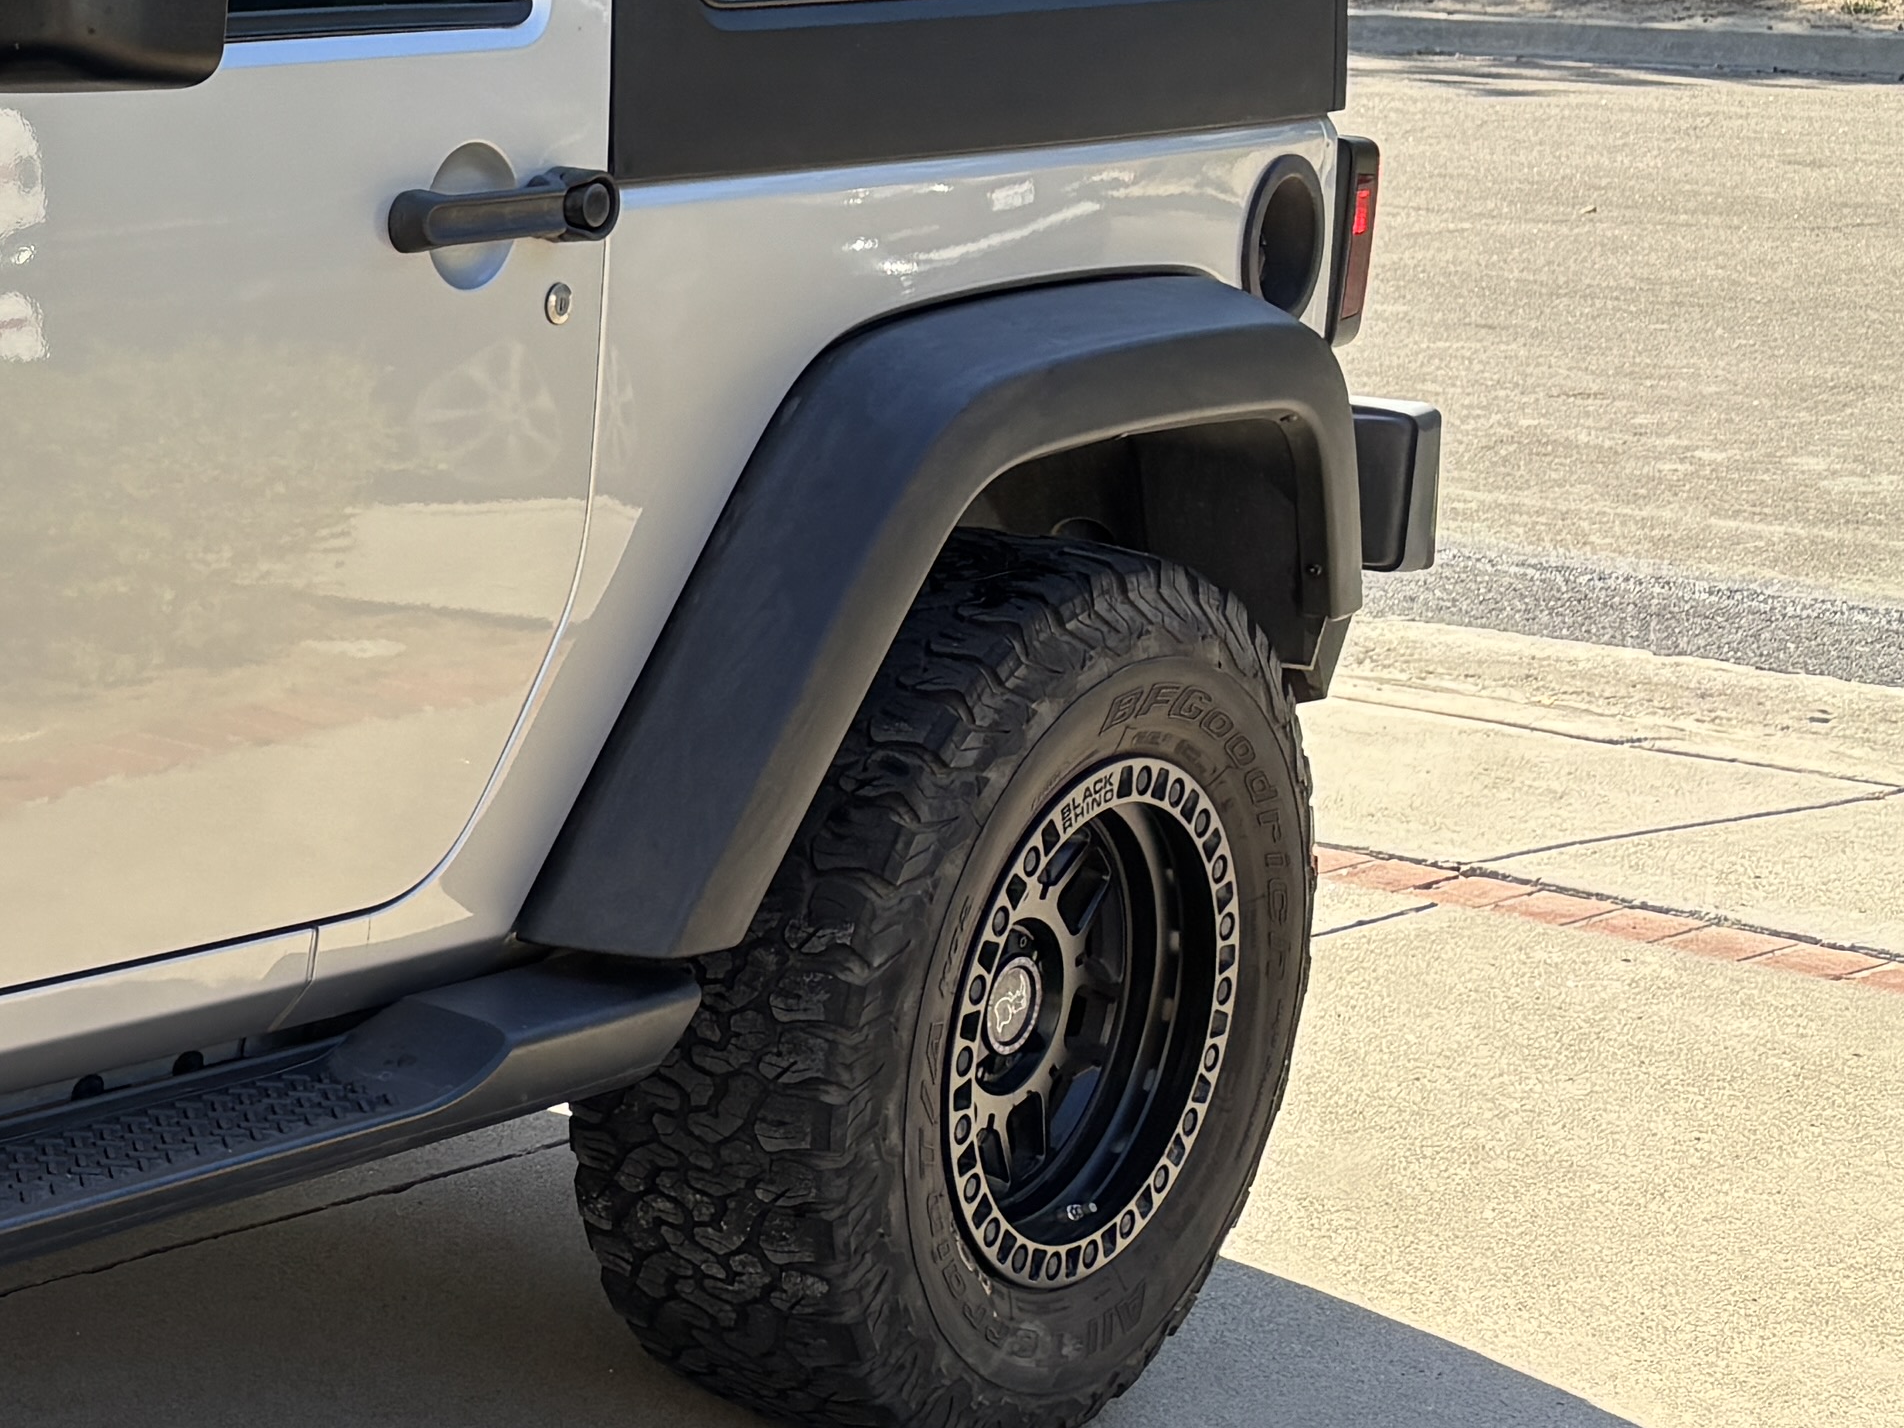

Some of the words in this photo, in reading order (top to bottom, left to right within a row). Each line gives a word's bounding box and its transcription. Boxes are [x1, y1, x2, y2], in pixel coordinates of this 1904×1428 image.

[1060, 772, 1114, 822] BLACK
[1062, 788, 1114, 835] RHINO
[1103, 681, 1289, 982] BFGoodrich
